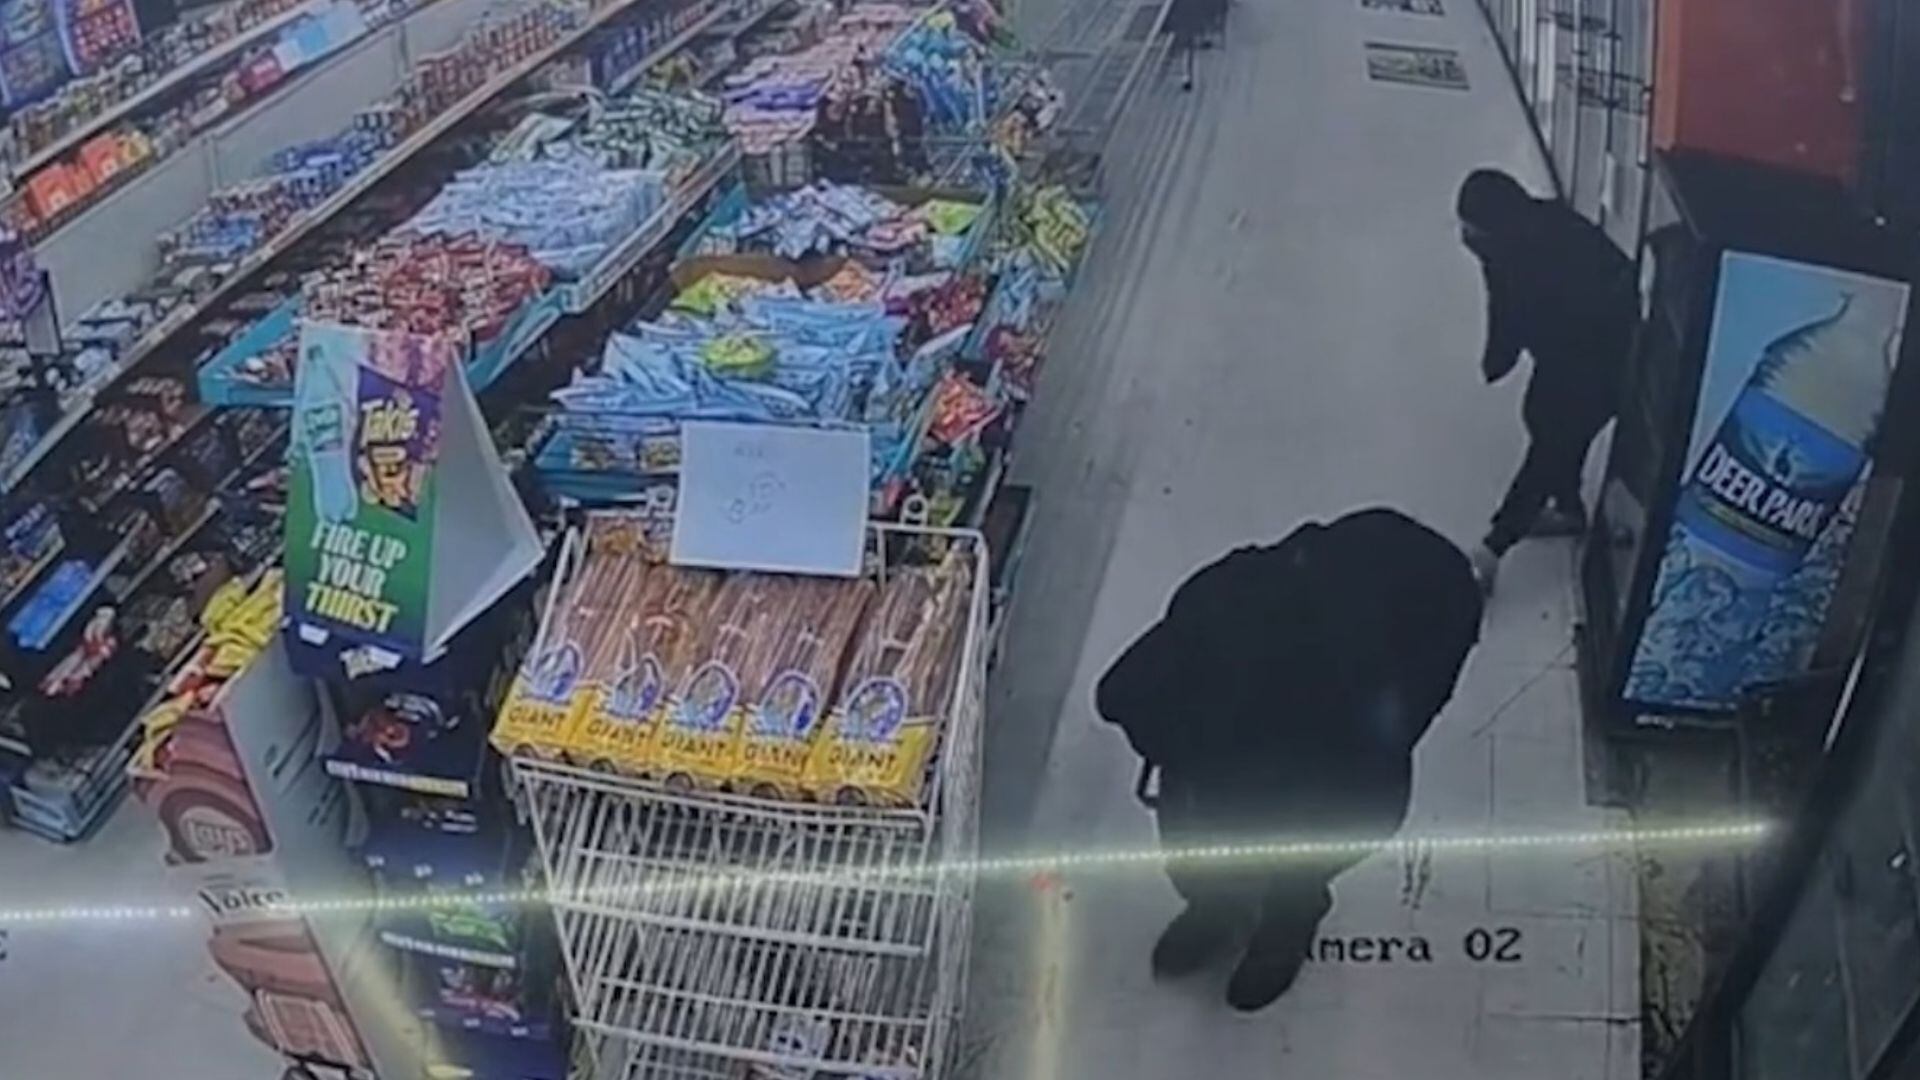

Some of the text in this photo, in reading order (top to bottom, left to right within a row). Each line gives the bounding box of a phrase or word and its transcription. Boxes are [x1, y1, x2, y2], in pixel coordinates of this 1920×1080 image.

[1697, 442, 1767, 514] DEER
[310, 520, 408, 569] FIRE UP
[317, 553, 387, 599] YOUR
[305, 581, 400, 634] THIRST
[507, 703, 567, 730] GIANT
[586, 718, 648, 746] GIANT
[661, 731, 728, 760] GIANT
[827, 745, 897, 774] GIANT
